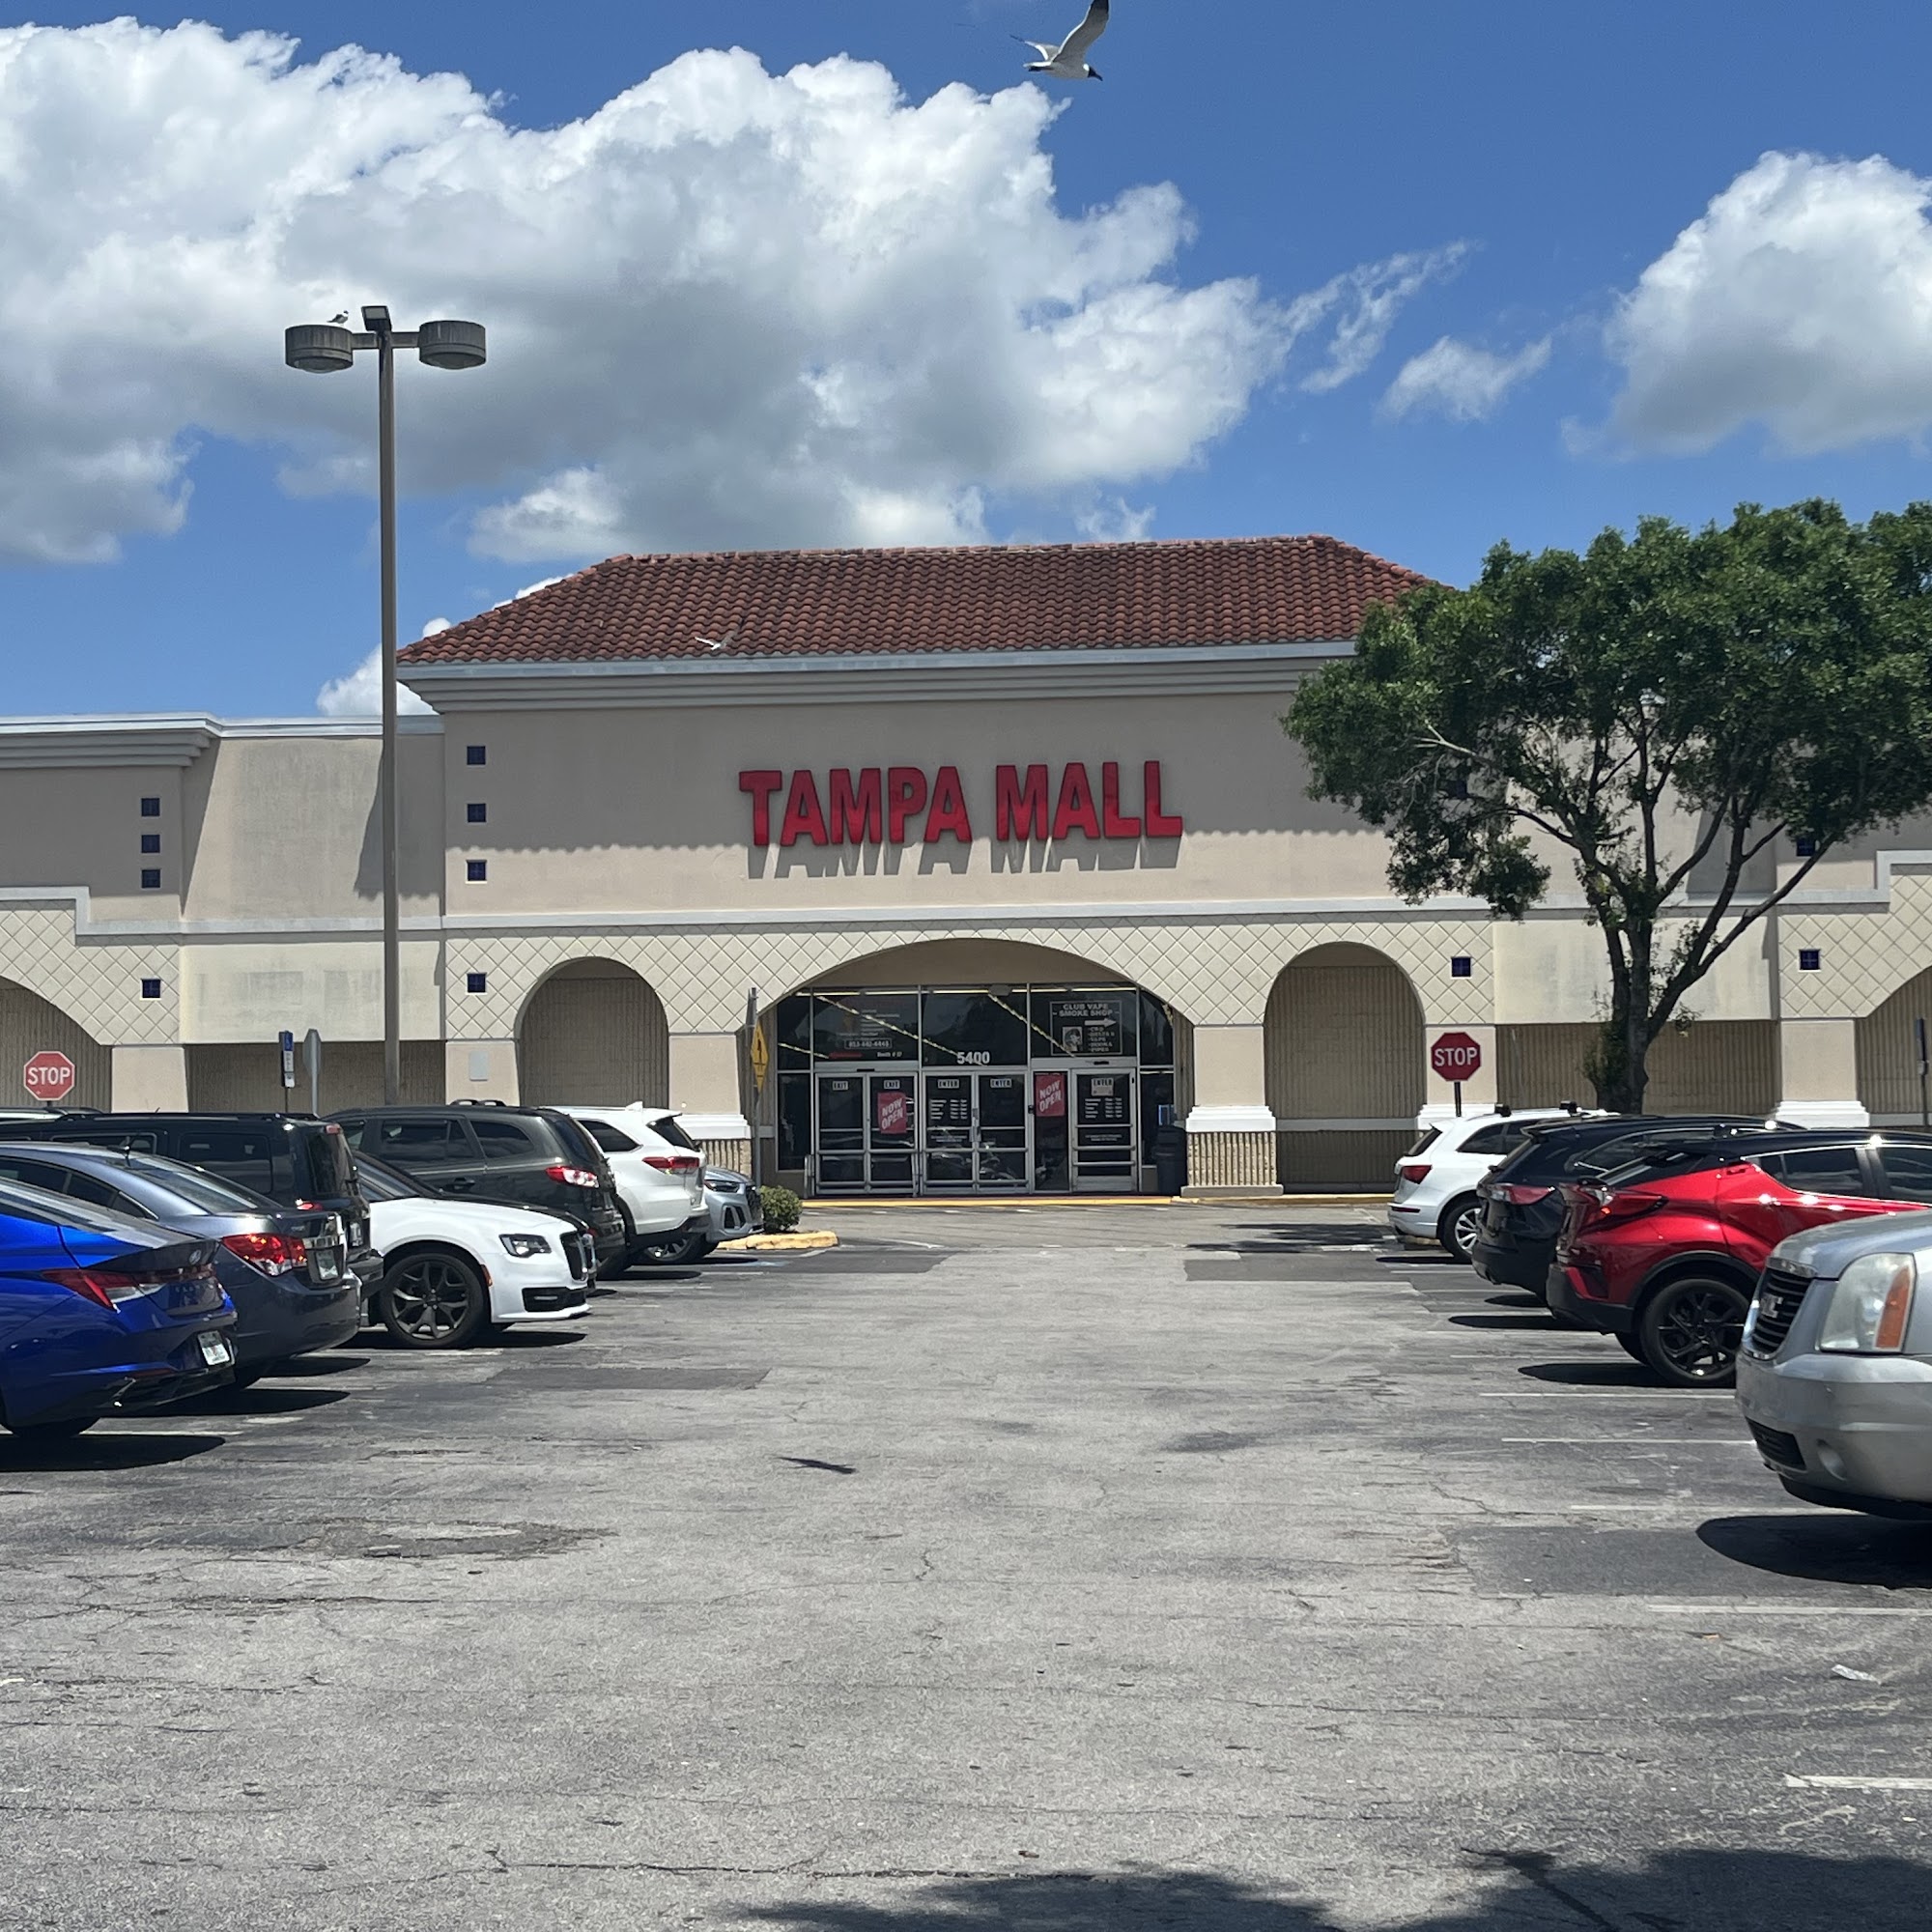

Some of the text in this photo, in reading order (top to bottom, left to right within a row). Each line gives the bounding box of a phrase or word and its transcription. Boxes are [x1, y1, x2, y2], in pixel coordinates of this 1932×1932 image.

[739, 760, 1183, 846] TAMPA MALL
[957, 1051, 990, 1065] 5400
[1435, 1046, 1478, 1066] STOP
[27, 1066, 71, 1086] STOP
[1039, 1080, 1061, 1099] NOW
[882, 1097, 903, 1117] NOW
[1039, 1090, 1062, 1112] OPEN
[881, 1107, 903, 1129] OPEN
